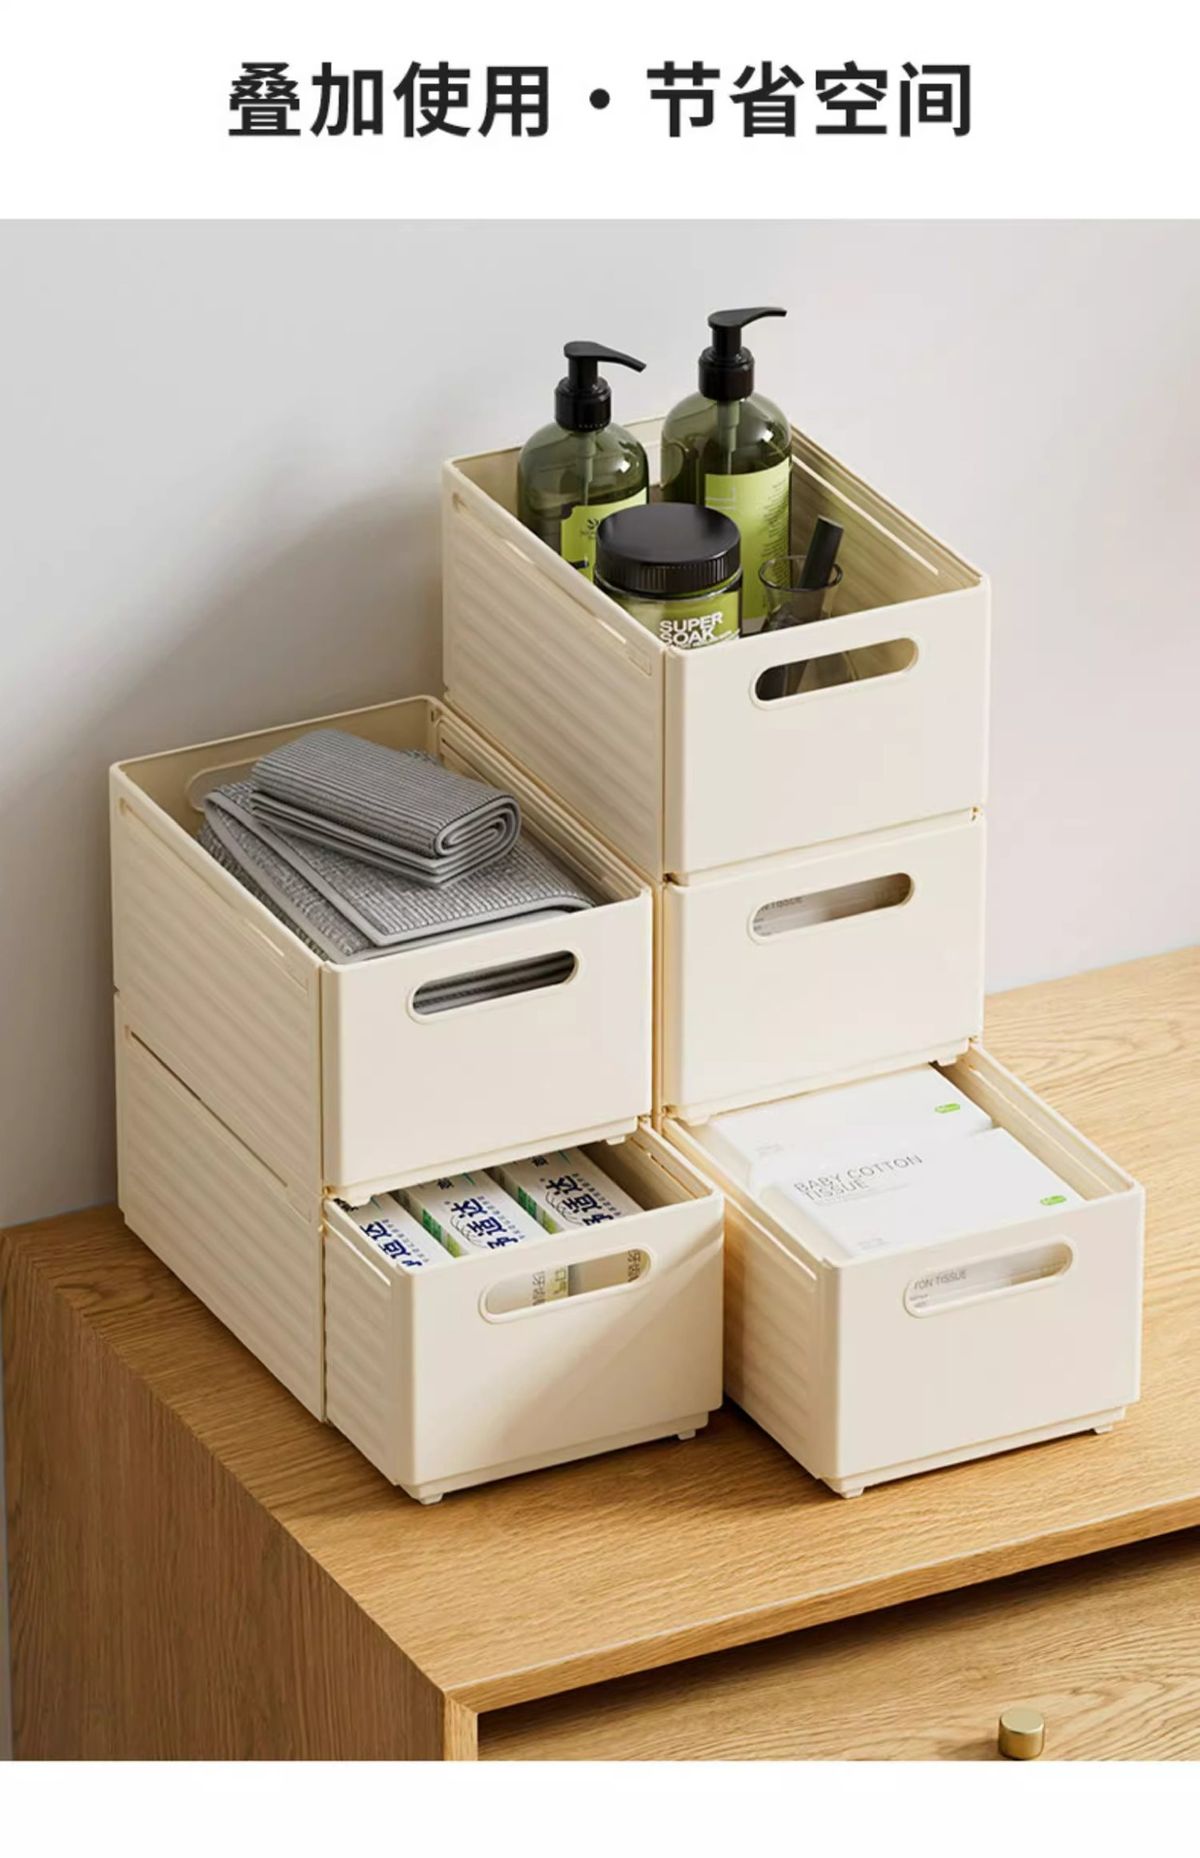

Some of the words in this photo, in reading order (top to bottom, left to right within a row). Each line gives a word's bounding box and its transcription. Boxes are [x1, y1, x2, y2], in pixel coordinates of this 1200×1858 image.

[660, 612, 723, 632] SUPER
[660, 628, 716, 646] SOAK
[793, 1173, 842, 1193] BABY
[846, 1154, 923, 1179] COTTON
[804, 1179, 869, 1201] TISSUE
[936, 1269, 967, 1285] TISSUE
